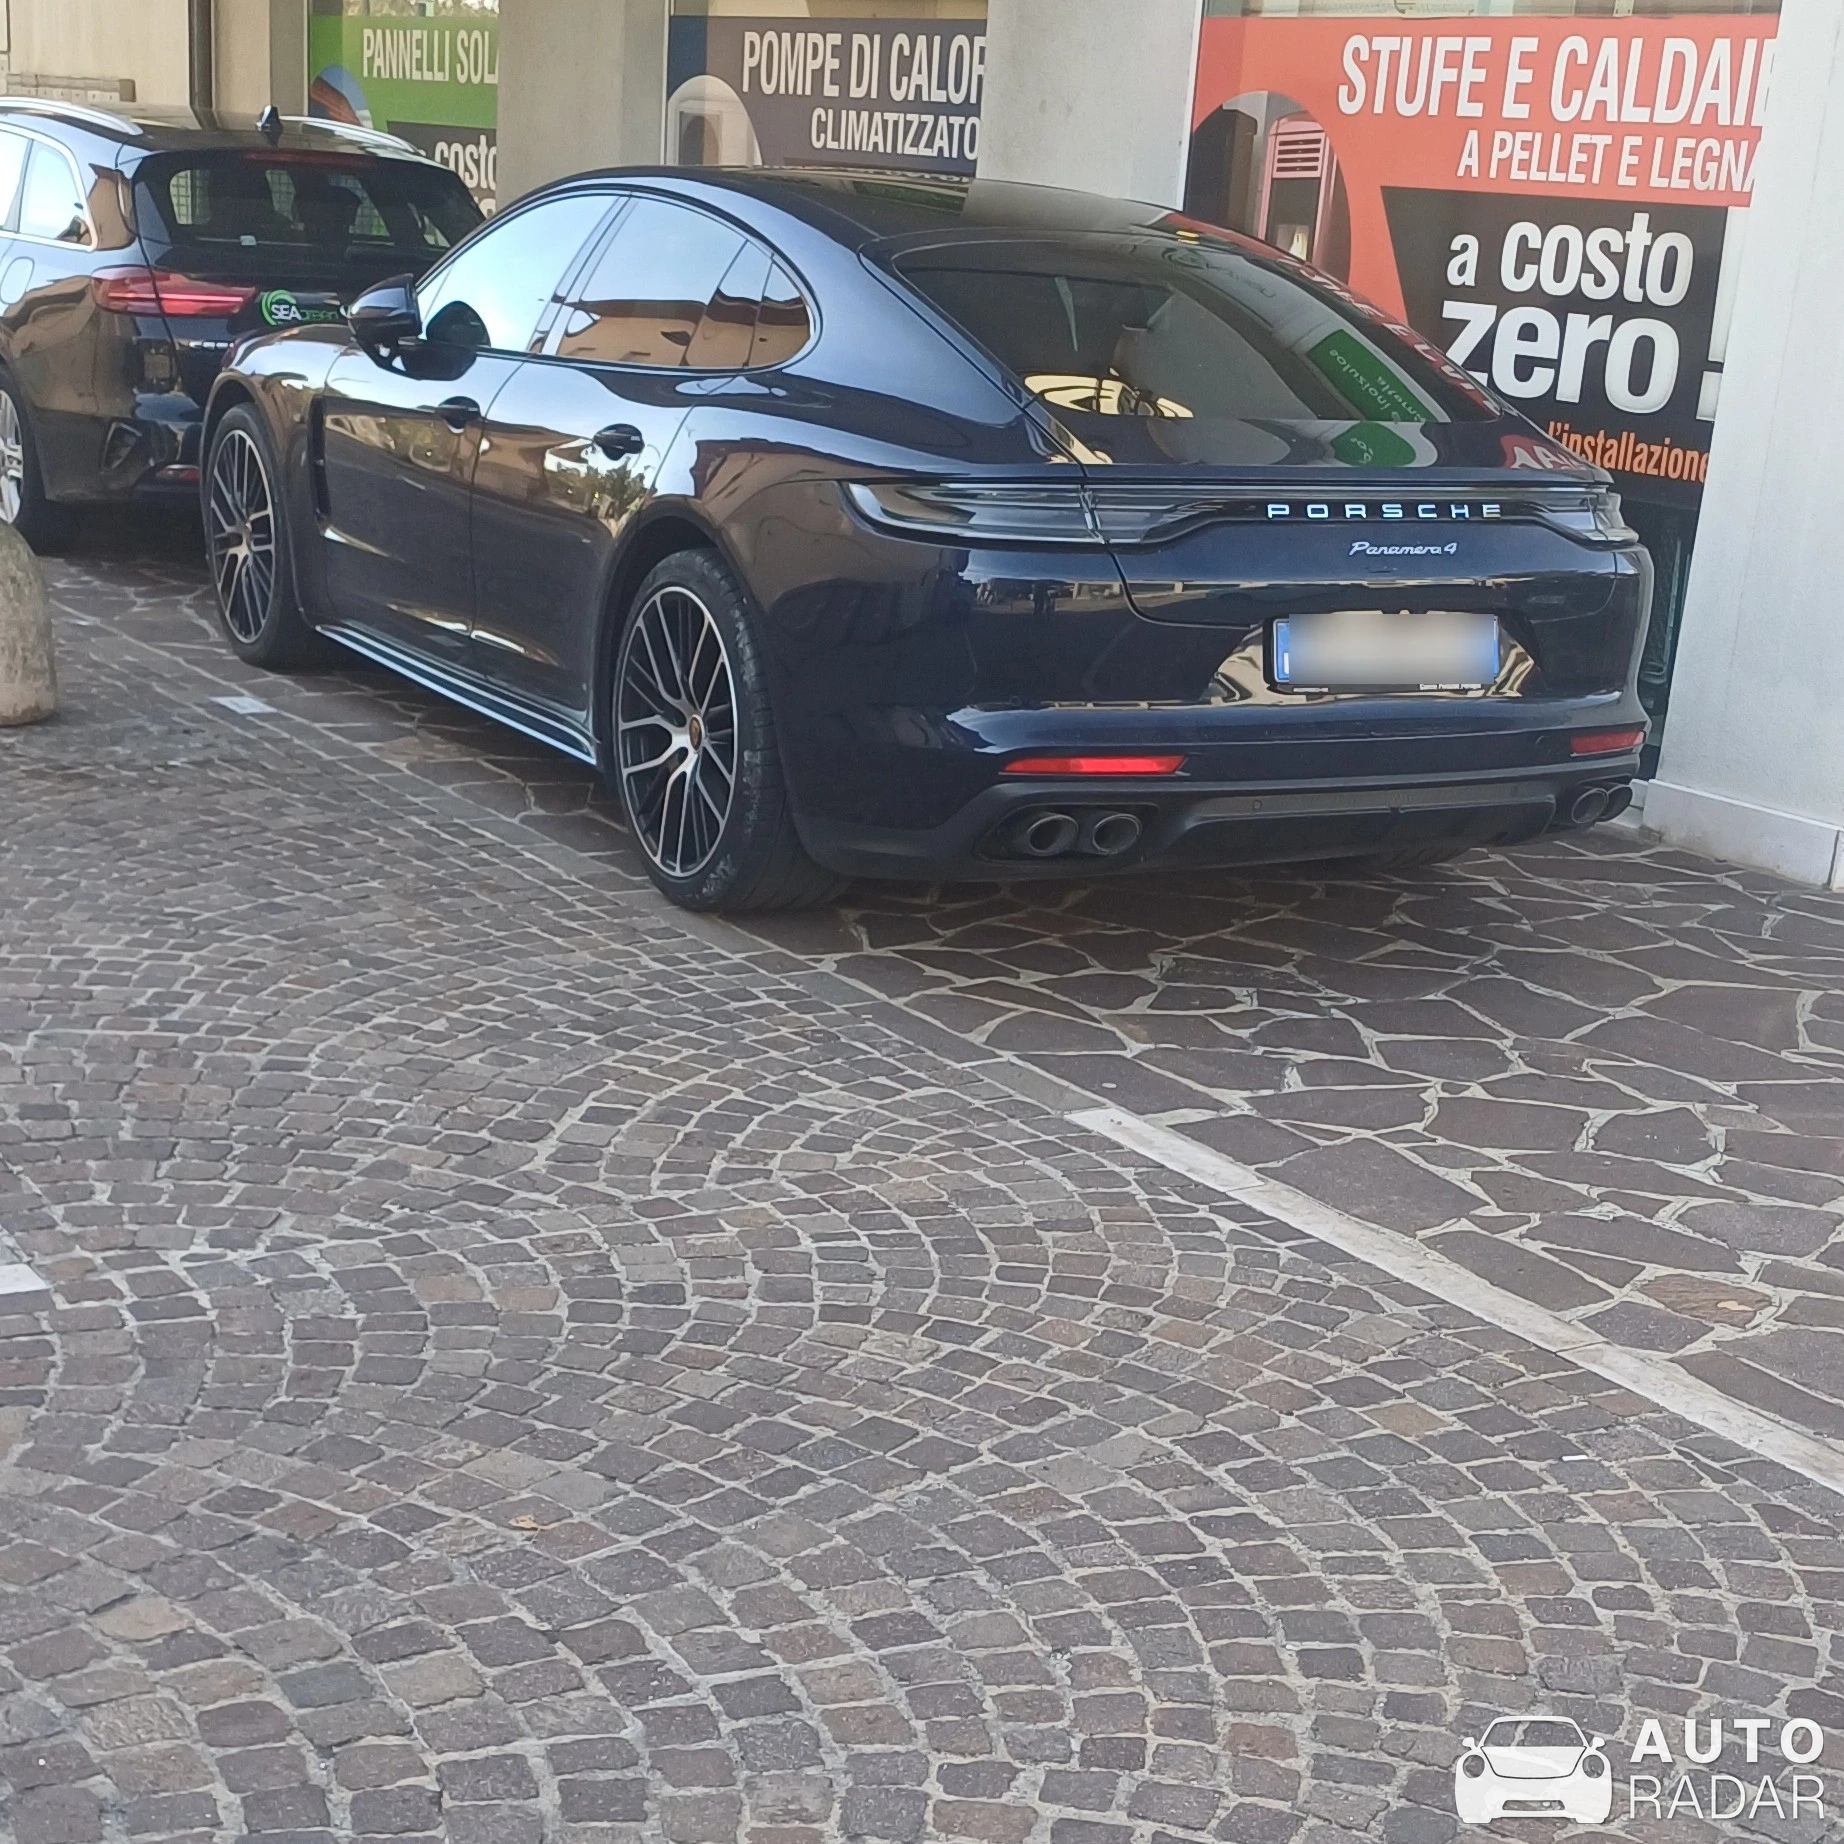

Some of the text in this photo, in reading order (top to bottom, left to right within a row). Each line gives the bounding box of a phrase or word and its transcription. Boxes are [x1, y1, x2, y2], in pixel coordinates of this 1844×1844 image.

[363, 28, 498, 84] PANNELLI SOL
[743, 31, 842, 97] POMPE
[849, 33, 881, 99] DI
[1338, 34, 1492, 117] STUFE
[1501, 36, 1539, 119] E
[811, 107, 981, 161] CLIMATIZZATO
[1457, 129, 1479, 178] A
[1489, 130, 1613, 184] PELLET
[1617, 135, 1643, 187] E
[1446, 212, 1694, 307] a costo
[1442, 300, 1680, 414] zero
[1267, 503, 1501, 519] PORSCHE
[1349, 541, 1458, 556] Panamera 4
